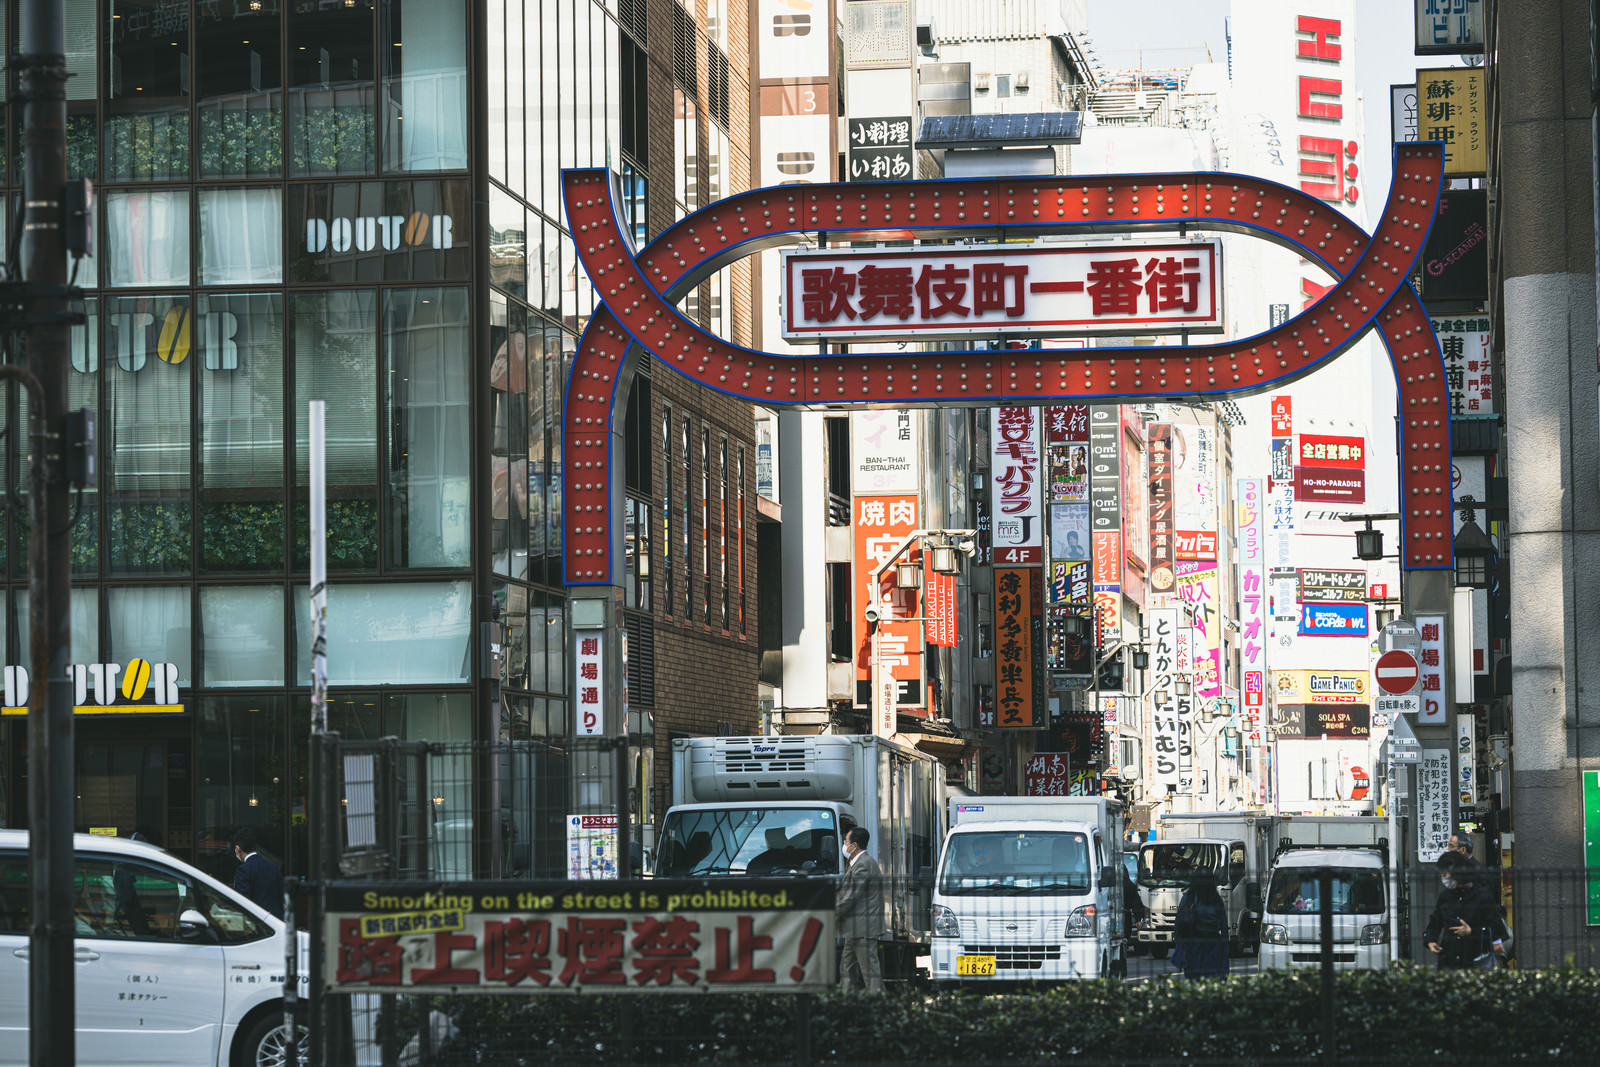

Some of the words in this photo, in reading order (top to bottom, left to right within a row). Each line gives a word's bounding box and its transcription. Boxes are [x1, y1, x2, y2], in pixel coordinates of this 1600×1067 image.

[1433, 16, 1470, 43] ビル
[1469, 76, 1478, 151] エレガンス・ラウンジ
[851, 120, 910, 145] 小料理
[851, 153, 911, 178] い利あ
[306, 211, 453, 253] DOUTOR
[801, 256, 1201, 323] 歌舞伎町一番街
[1480, 334, 1491, 401] リーチ麻雀
[1467, 360, 1479, 411] 専門店
[865, 456, 906, 464] BAN-THAI
[1302, 442, 1362, 461] 全店営業中
[859, 464, 911, 472] RESTAURANT
[858, 500, 915, 526] 焼肉
[1284, 483, 1293, 524] カラオケ
[1005, 549, 1031, 563] 4F
[1055, 562, 1066, 600] カフェ
[1242, 569, 1262, 664] カラオケ
[4, 657, 180, 707] DUTOR
[580, 637, 599, 728] 劇場通り
[1421, 623, 1441, 717] 劇場通り
[1318, 713, 1336, 722] SOLA
[1337, 713, 1351, 722] SPA
[1379, 700, 1417, 710] 自転車を除く
[1277, 726, 1302, 735] AUNA
[753, 744, 776, 753] Topre
[1027, 754, 1066, 777] 湖南
[1431, 759, 1441, 843] 防犯カメラ作動中
[482, 894, 508, 909] on
[517, 890, 554, 909] the
[562, 890, 632, 909] street
[640, 890, 660, 909] is
[667, 889, 794, 911] prohibited.
[365, 911, 459, 934] 新宿区内全域
[966, 963, 993, 974] 18-67
